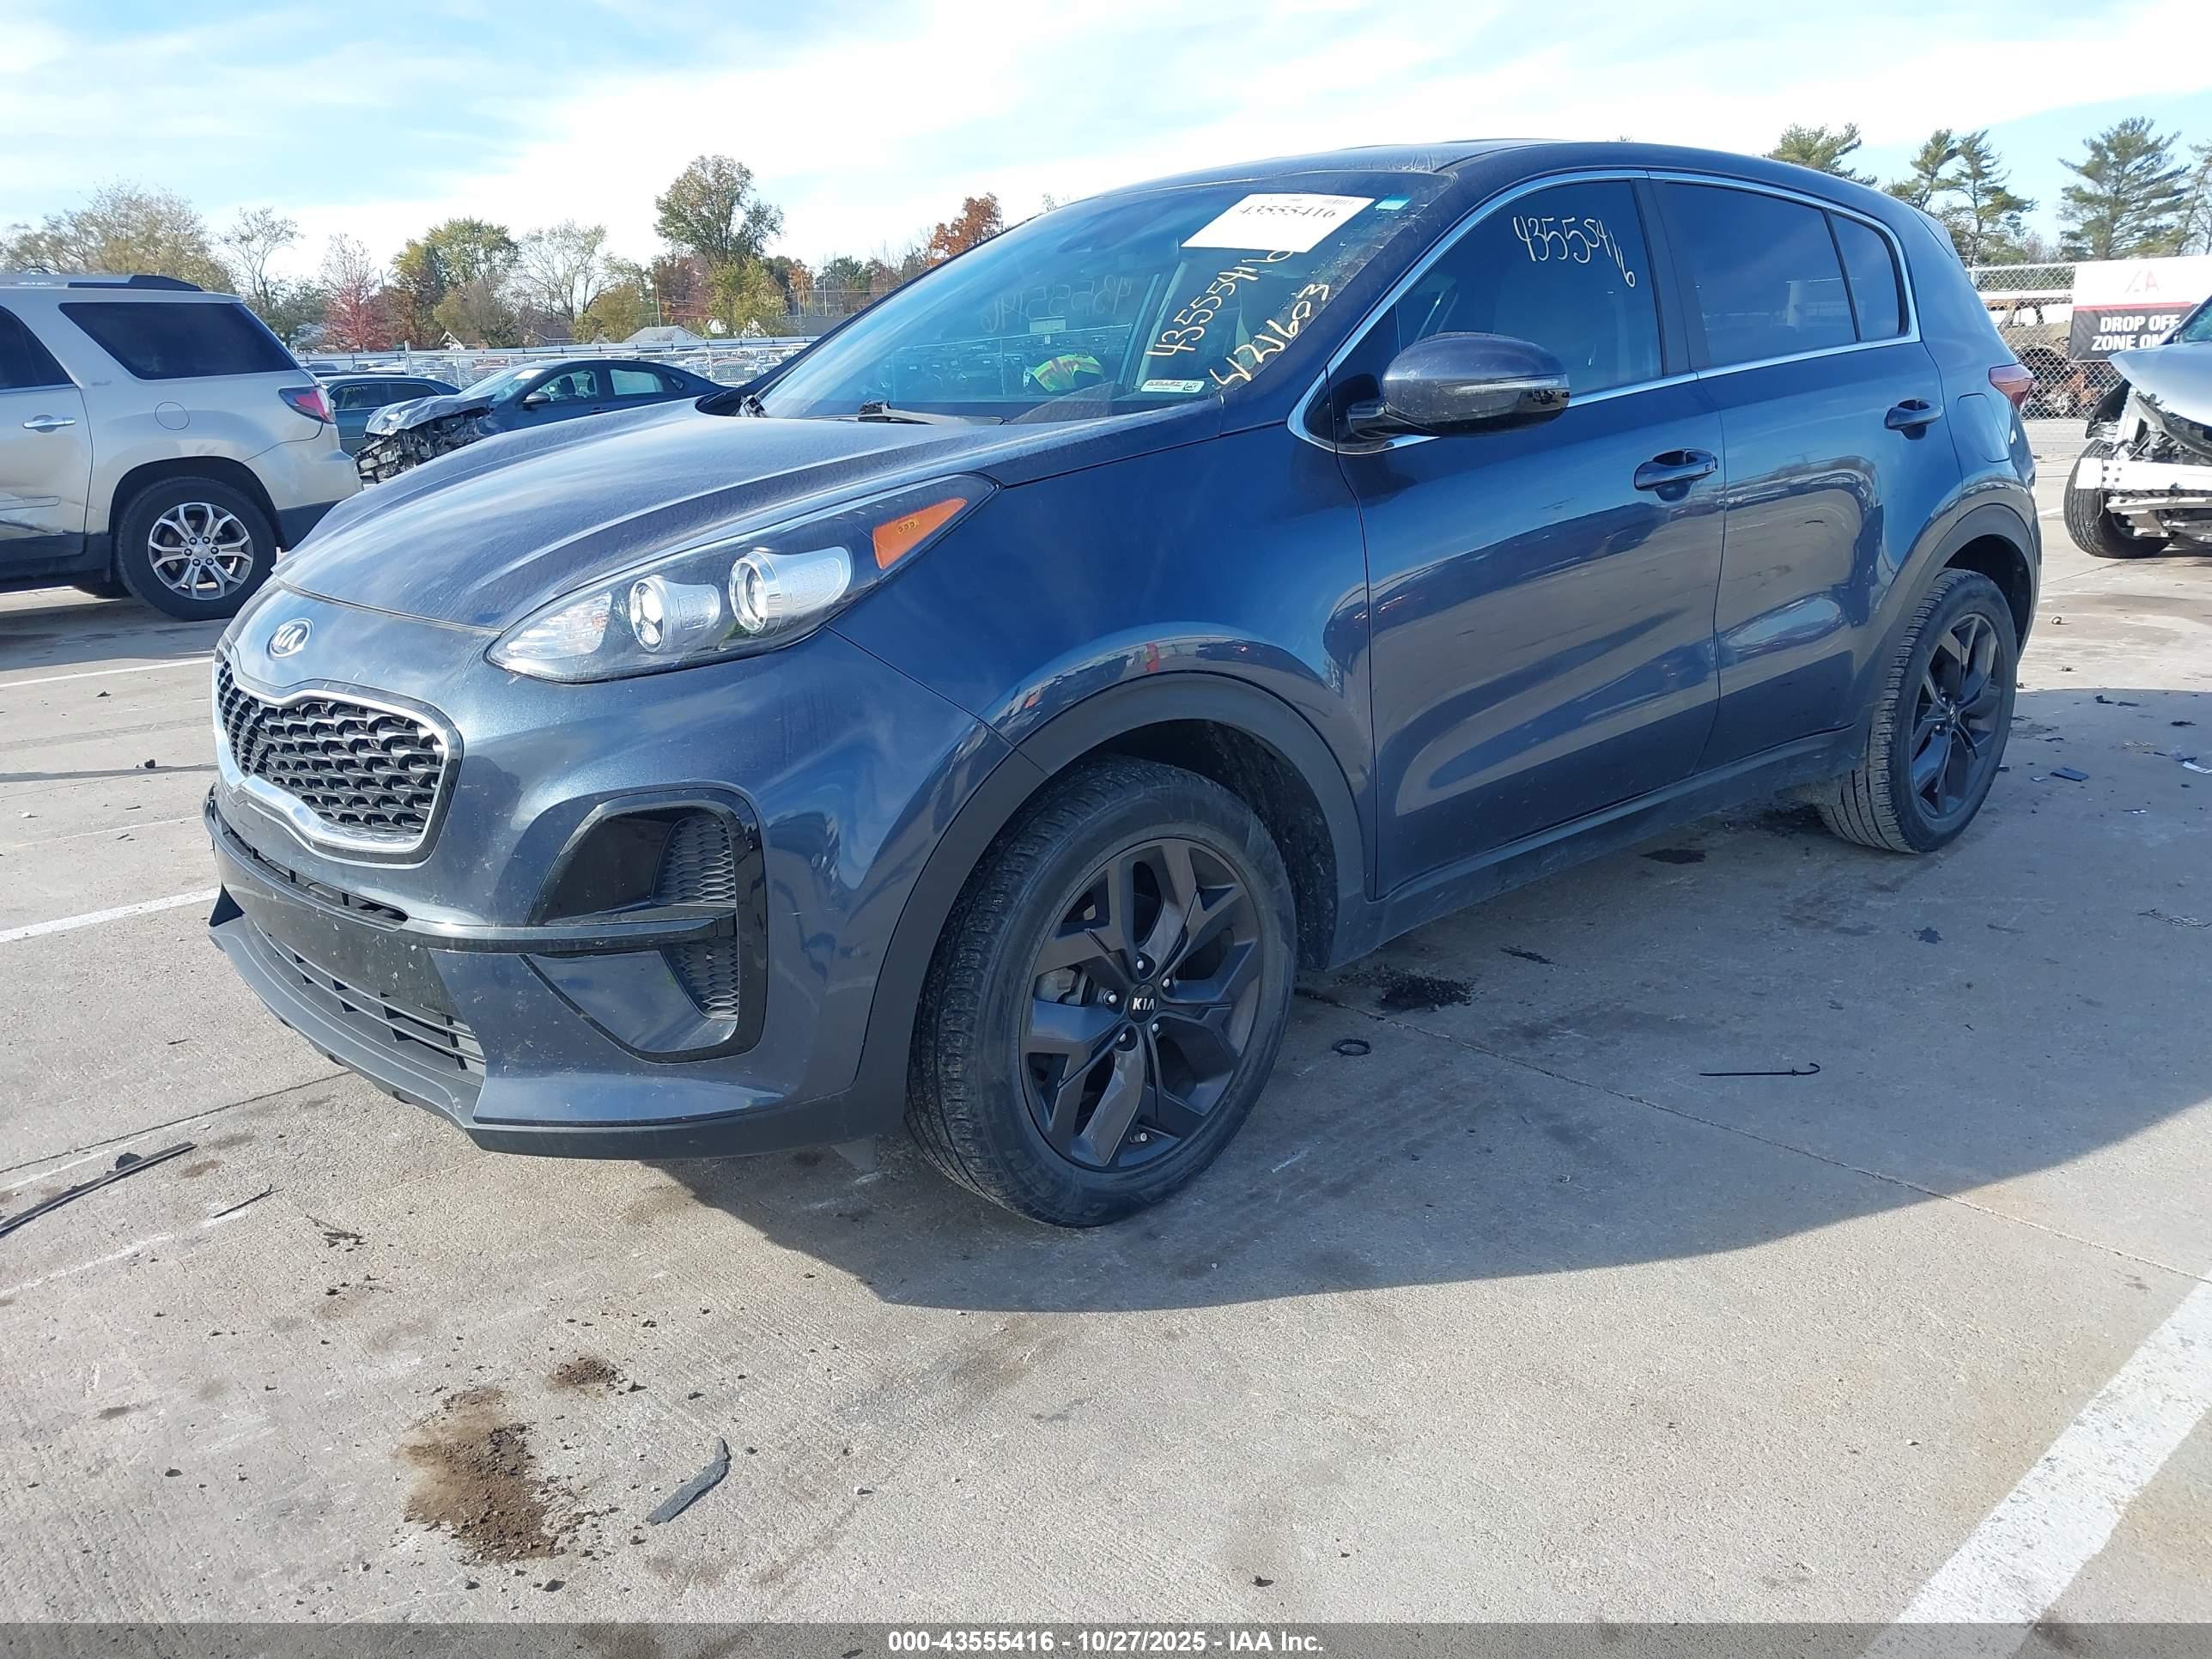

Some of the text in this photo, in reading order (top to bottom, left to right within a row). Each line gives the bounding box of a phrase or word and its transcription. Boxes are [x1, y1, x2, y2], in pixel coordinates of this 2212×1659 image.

[2100, 314, 2181, 332] DROP OFF
[2091, 334, 2137, 351] ZONE
[1132, 997, 1155, 1011] KIA
